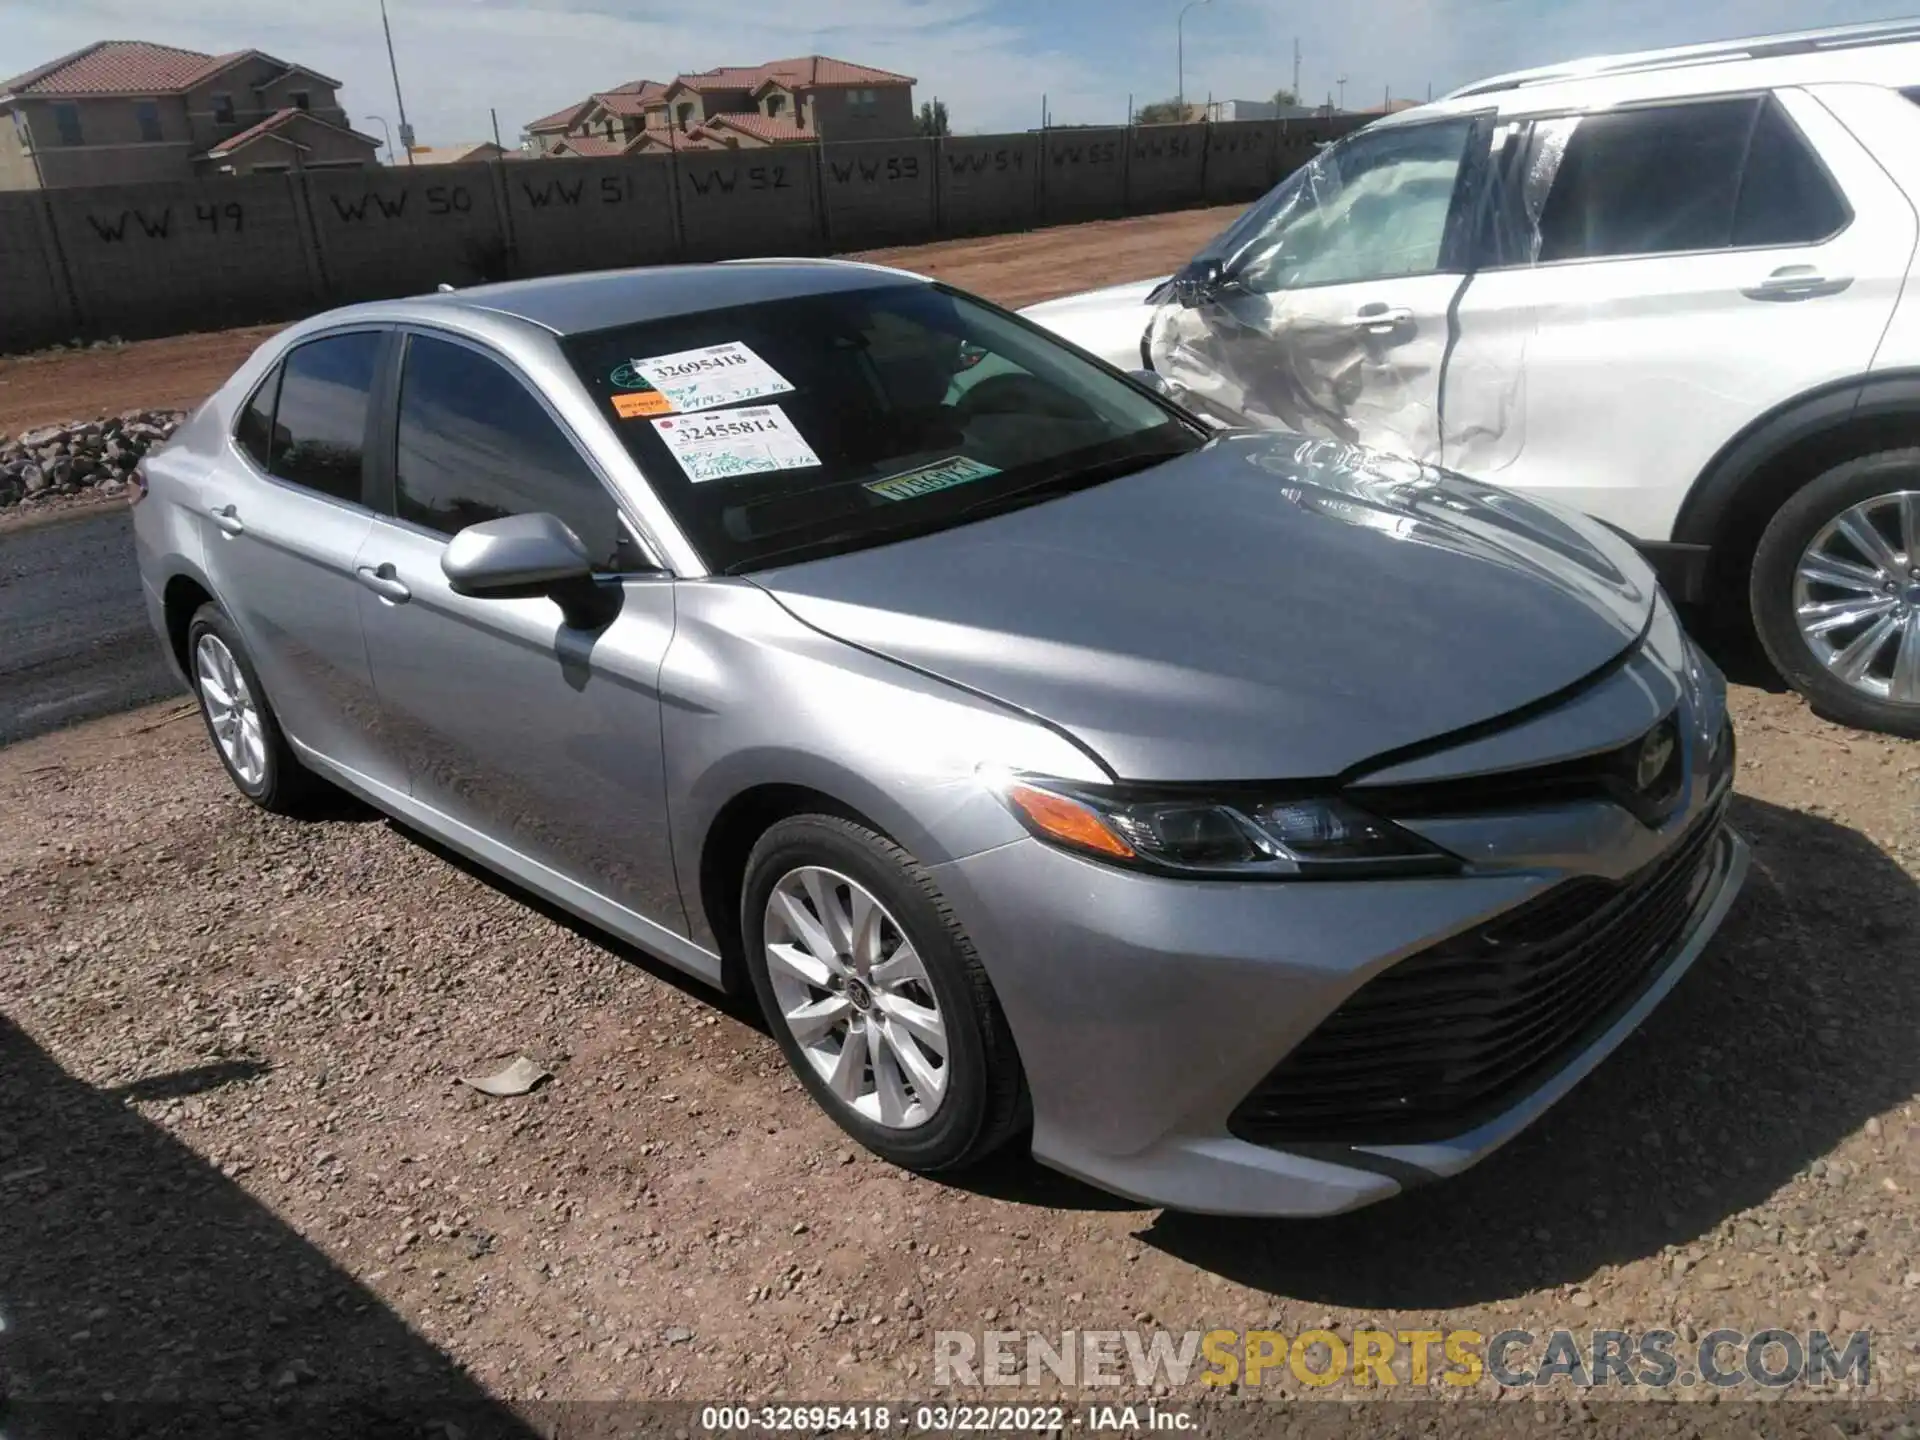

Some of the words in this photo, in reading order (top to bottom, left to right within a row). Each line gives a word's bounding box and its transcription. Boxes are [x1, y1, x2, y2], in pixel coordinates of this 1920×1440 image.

[948, 151, 988, 174] WW
[995, 149, 1023, 171] 54
[1050, 144, 1082, 165] WW
[688, 168, 739, 195] WW
[749, 165, 792, 189] 52
[832, 157, 880, 183] WW
[886, 156, 919, 180] 53
[330, 190, 407, 222] WW
[425, 186, 472, 215] 50
[522, 178, 584, 208] WW
[600, 175, 633, 203] 51
[87, 207, 170, 243] WW
[195, 201, 243, 234] 49
[653, 353, 747, 379] 32695418
[676, 418, 778, 442] 32455814
